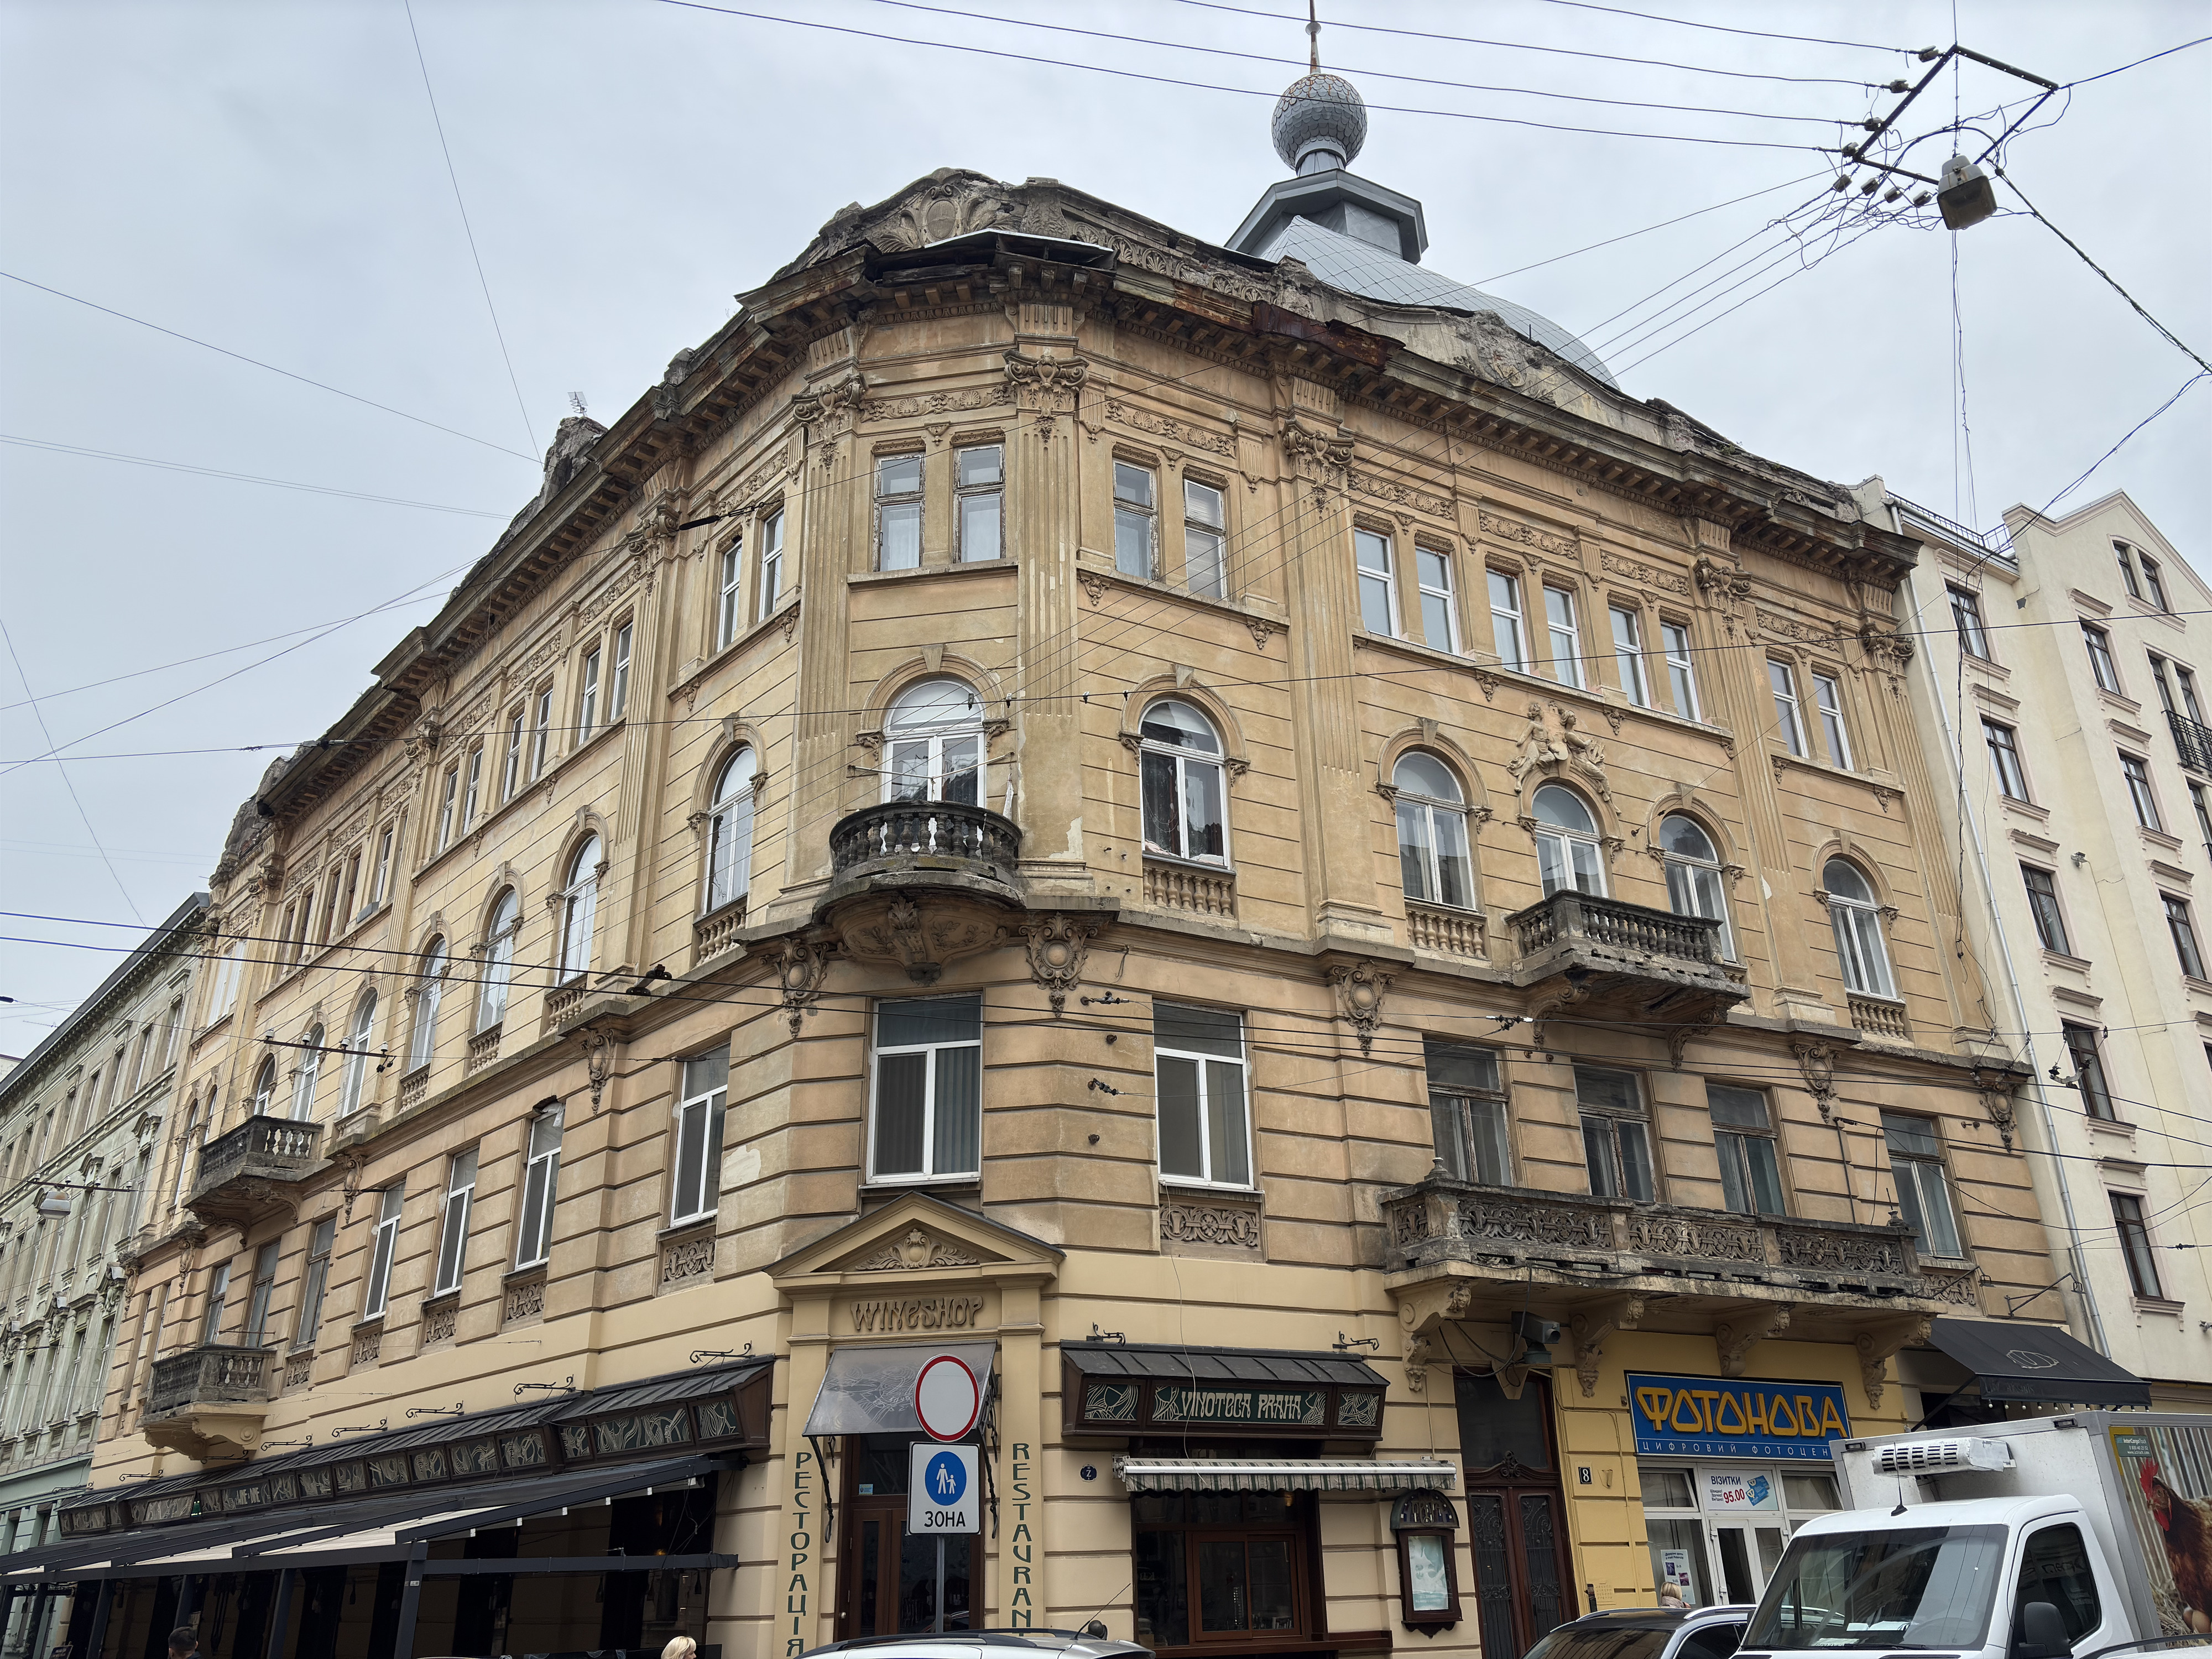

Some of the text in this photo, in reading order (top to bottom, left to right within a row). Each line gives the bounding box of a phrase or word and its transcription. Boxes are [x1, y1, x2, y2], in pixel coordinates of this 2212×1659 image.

[1257, 1394, 1301, 1420] PRAHA
[1635, 1386, 1848, 1438] ФОТОНОВА
[1642, 1441, 1736, 1454] ЦИФРОВИЙ
[1583, 1469, 1589, 1482] 8
[1711, 1476, 1741, 1485] ВІЗИТКИ
[1723, 1488, 1745, 1504] 95.00
[924, 1511, 966, 1527] ЗОНА
[786, 1452, 812, 1657] РЕСТОРАЦІЯ
